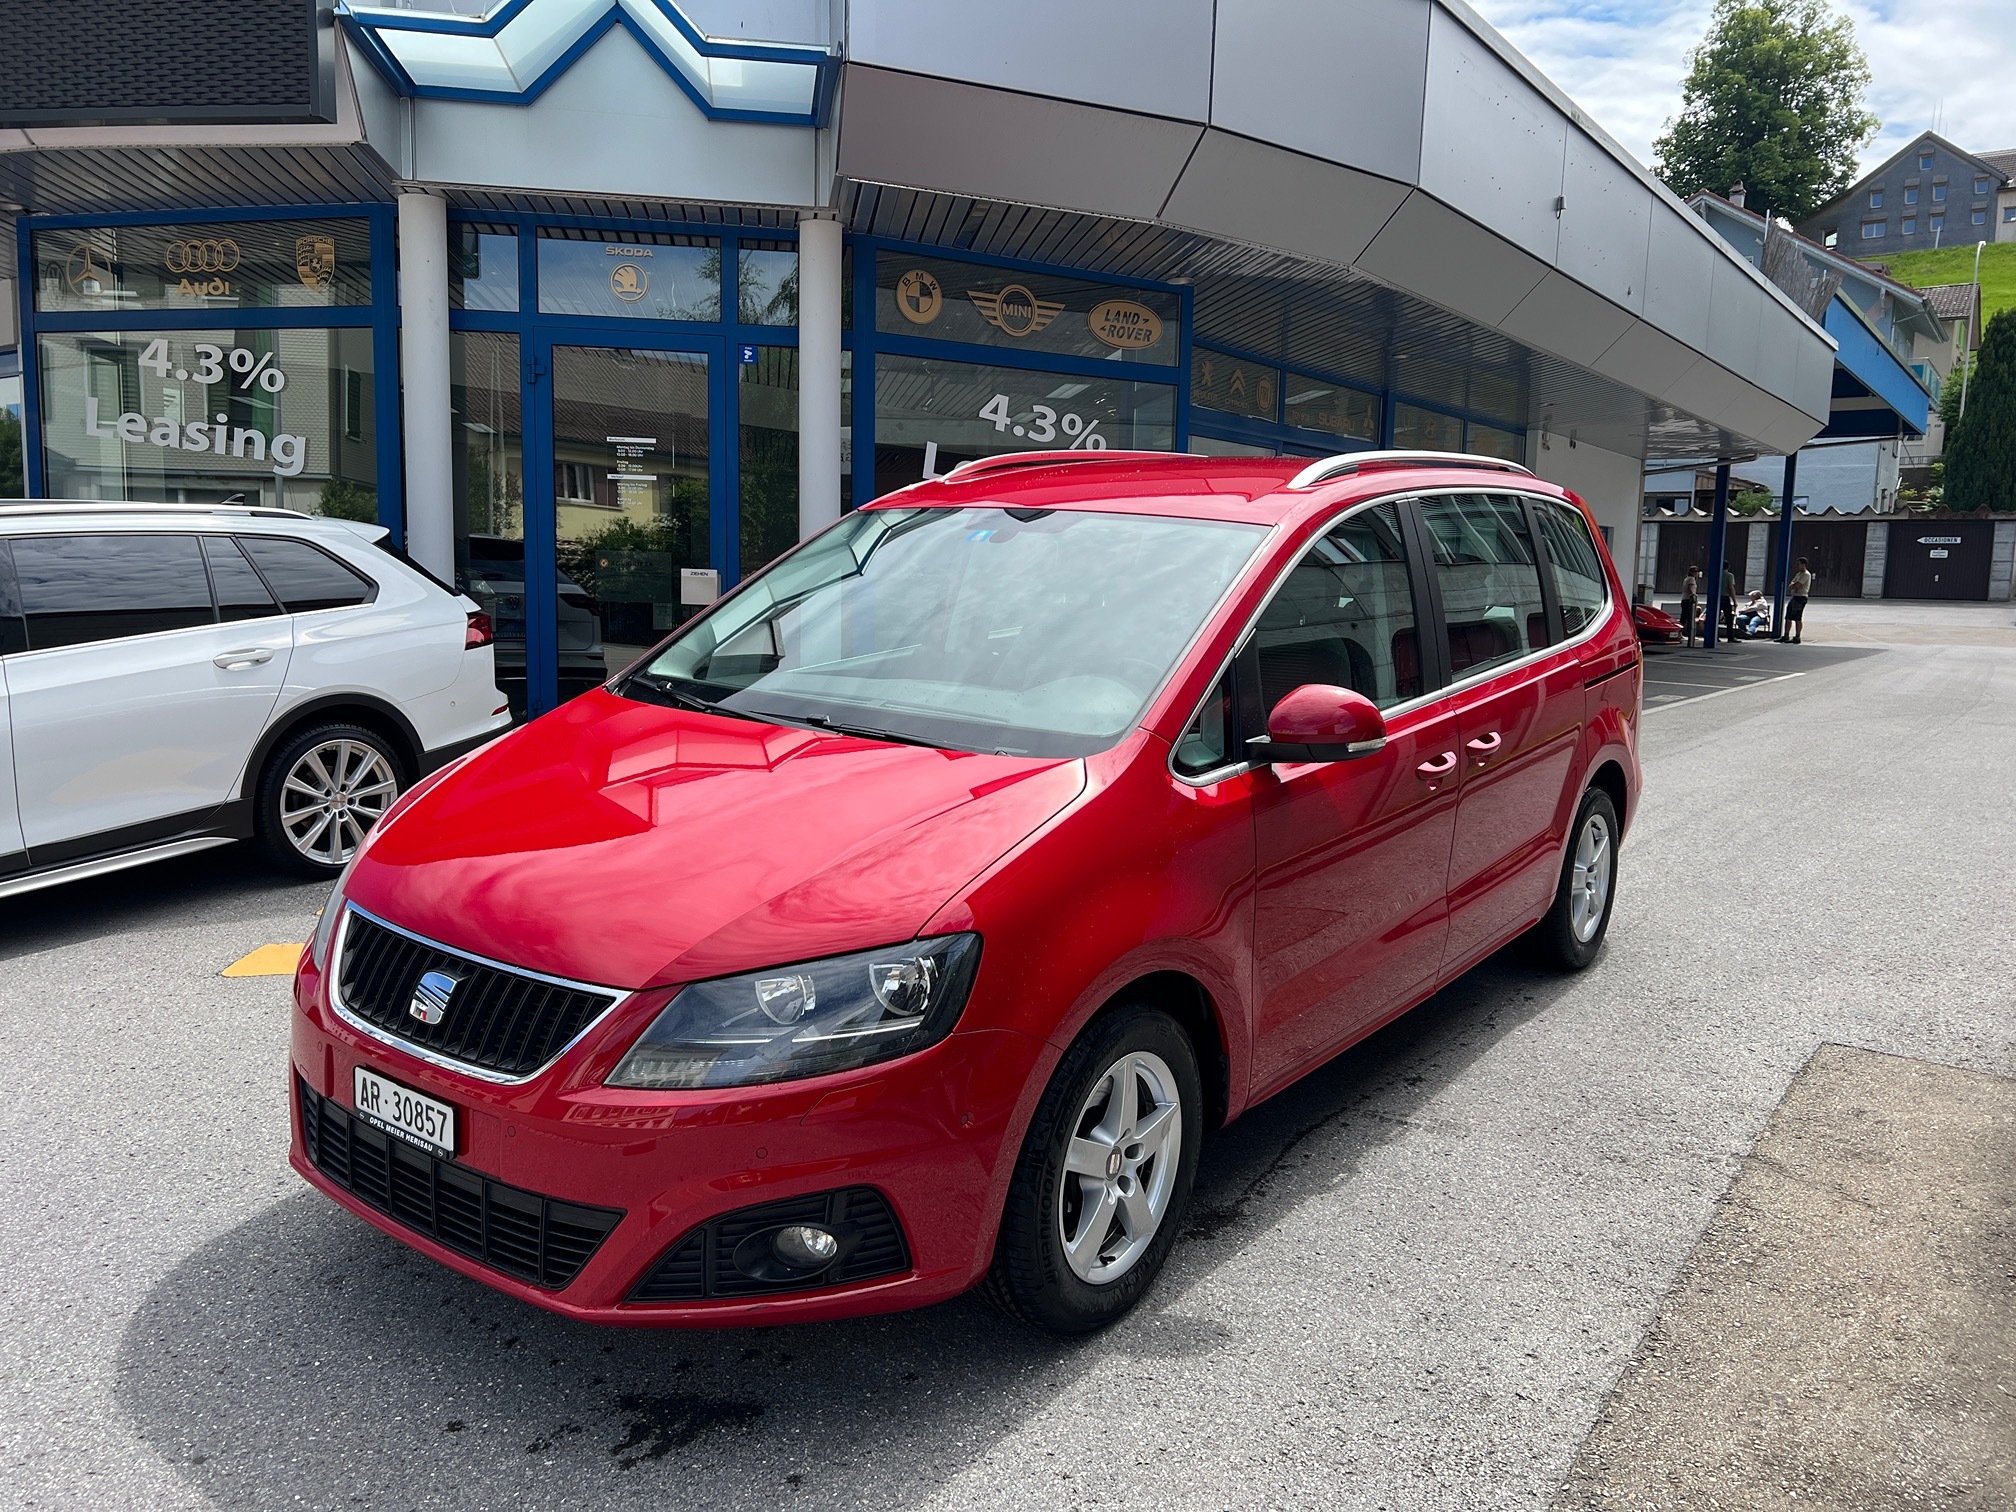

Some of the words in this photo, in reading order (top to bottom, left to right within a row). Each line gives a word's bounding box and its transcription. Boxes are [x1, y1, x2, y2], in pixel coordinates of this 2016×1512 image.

[176, 277, 230, 296] Audi
[901, 272, 938, 291] BMW
[1002, 302, 1032, 319] MINI
[1103, 308, 1140, 326] LAND
[1106, 324, 1153, 343] ROVER
[138, 339, 285, 393] 4.3%
[978, 393, 1107, 450] 4.3%
[1318, 411, 1355, 431] SUBARU
[86, 396, 307, 476] Leasing
[369, 1116, 385, 1129] OPEL
[385, 1124, 405, 1139] MEIER
[405, 1132, 433, 1152] HERISAU
